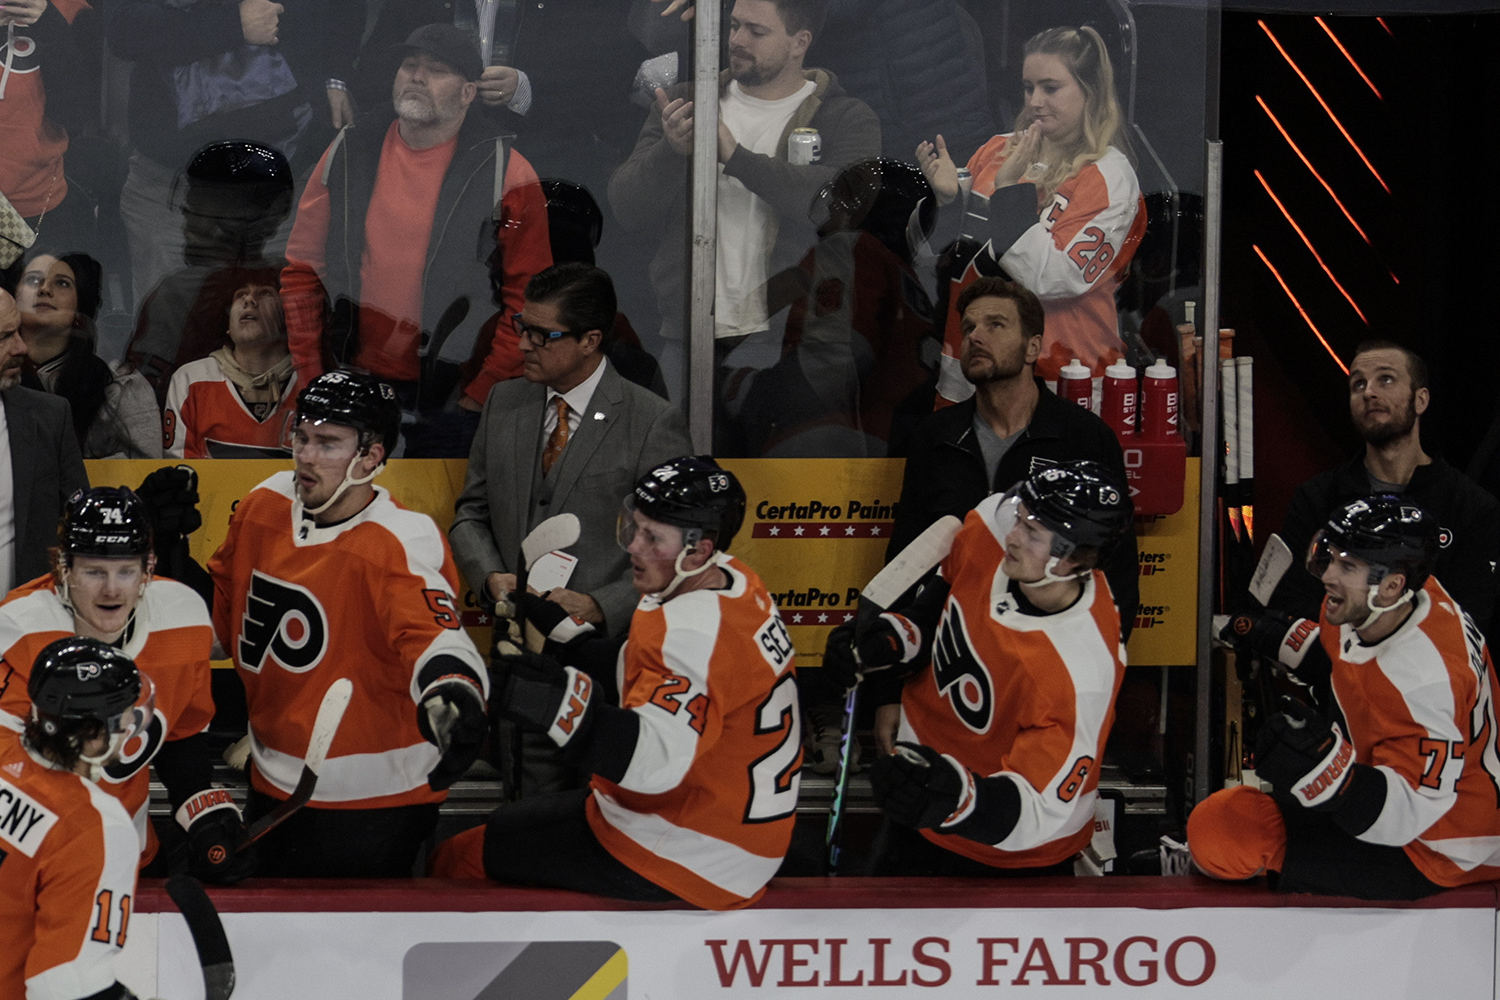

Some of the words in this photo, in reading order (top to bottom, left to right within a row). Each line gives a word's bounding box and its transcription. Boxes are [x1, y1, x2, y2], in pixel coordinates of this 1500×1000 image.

[1067, 226, 1115, 284] 28
[304, 394, 329, 404] CCM
[100, 507, 125, 525] 74
[635, 487, 656, 503] CCM
[756, 500, 841, 520] CertaPro
[847, 499, 899, 520] Paint
[650, 673, 711, 737] 24
[742, 671, 801, 824] 2
[91, 888, 131, 949] 11
[705, 937, 952, 988] WELLS
[977, 936, 1217, 987] FARGO
